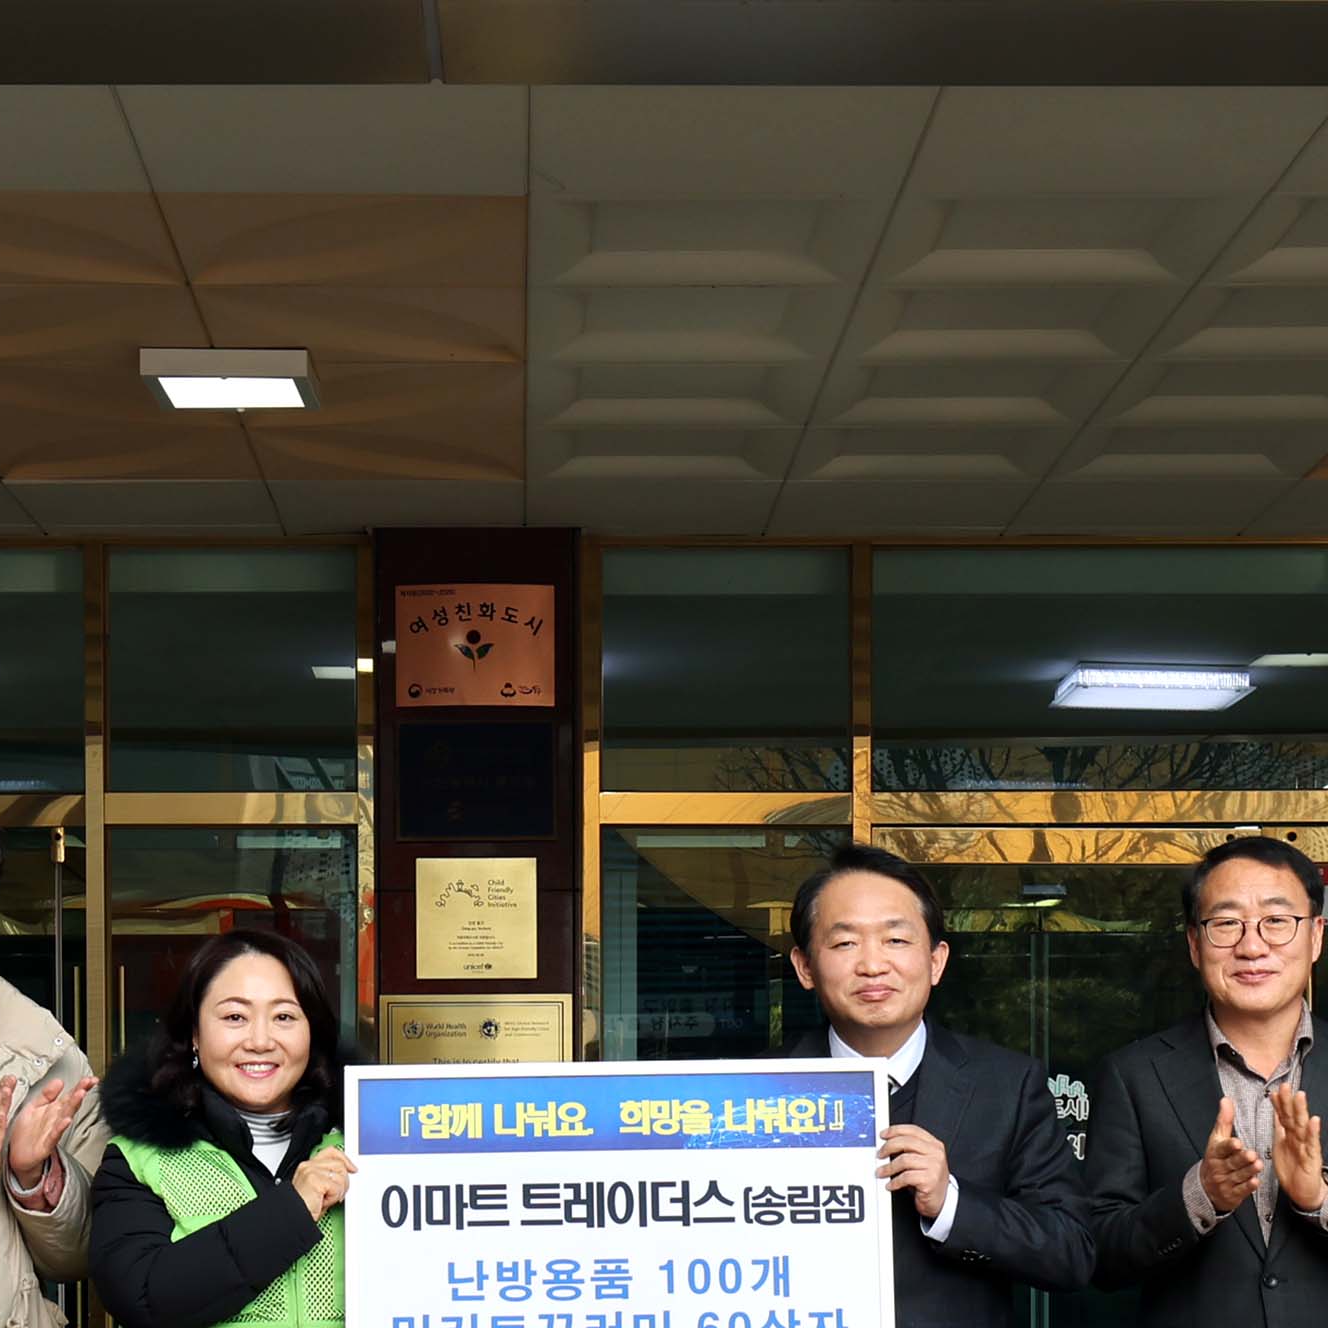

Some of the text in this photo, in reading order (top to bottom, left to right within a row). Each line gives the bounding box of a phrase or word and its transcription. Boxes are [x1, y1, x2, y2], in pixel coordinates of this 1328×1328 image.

[409, 602, 543, 636] 여성친화도시
[619, 1098, 712, 1138] 희망을
[381, 1180, 864, 1231] 이마트 트레이더스 (송림점)
[448, 1255, 790, 1302] 난방용품 100개
